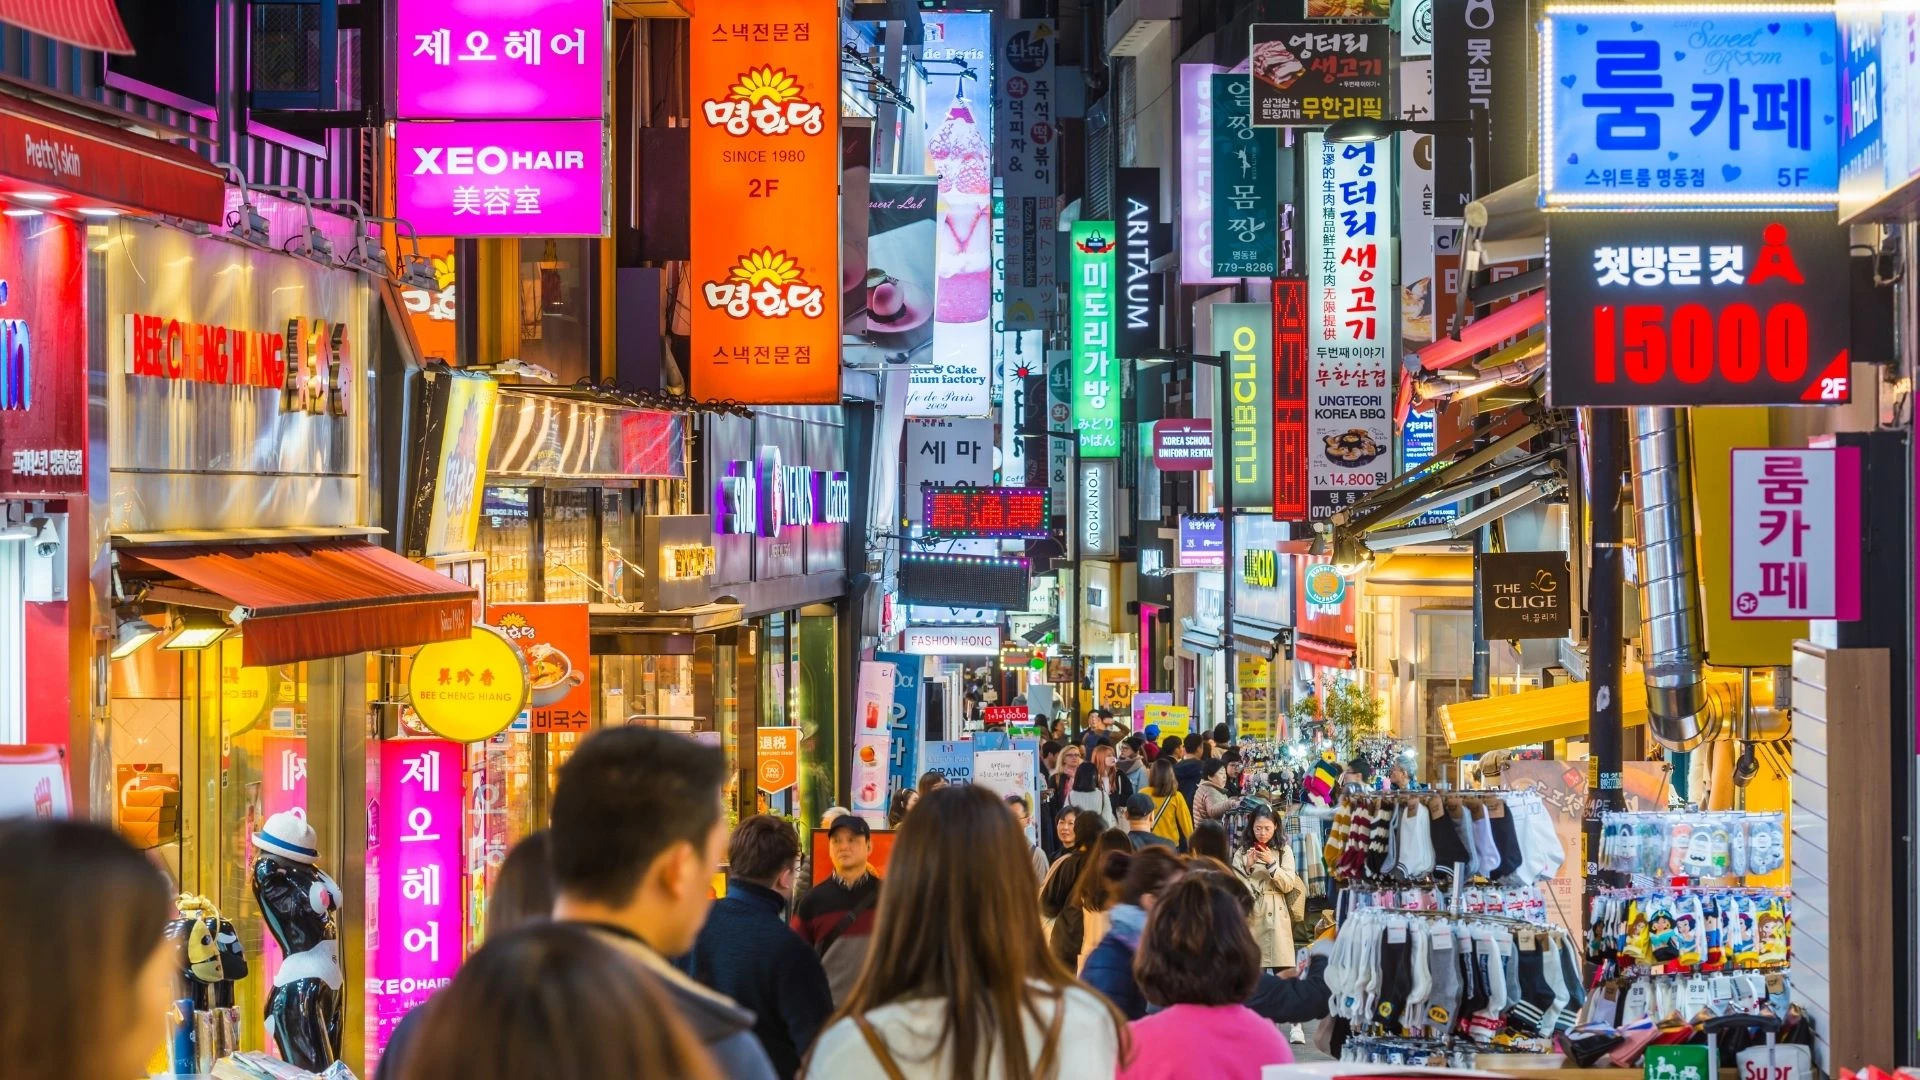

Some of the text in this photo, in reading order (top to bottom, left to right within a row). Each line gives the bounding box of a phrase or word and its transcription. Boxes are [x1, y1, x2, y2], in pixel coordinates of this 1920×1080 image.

[711, 22, 810, 42] 스낵전문점
[412, 27, 586, 66] 제오헤어
[1289, 33, 1368, 59] 엉터리
[1311, 55, 1382, 84] 생고기
[703, 97, 824, 136] 명화당
[1262, 109, 1300, 119] 된장찌개
[1302, 96, 1382, 119] 무한리필
[412, 146, 584, 176] XEO HAIR
[722, 150, 806, 163] SINCE 1980
[1584, 168, 1705, 187] 스위트룸 명동점
[1777, 167, 1810, 187] 5F
[748, 177, 779, 198] 2F
[452, 185, 542, 217] 美容室
[897, 196, 926, 209] Lab
[1339, 141, 1377, 340] 엉터리 생고기
[1127, 197, 1151, 329] ARITAUM
[1232, 251, 1257, 260] 명동점
[1594, 245, 1744, 286] 첫방문 컷
[1217, 263, 1274, 273] 779-8286
[703, 281, 825, 318] 명화당
[1083, 262, 1110, 409] 미도리가방
[1594, 303, 1808, 384] 15000
[134, 314, 163, 375] BEE
[167, 319, 228, 385] CHENG
[233, 330, 284, 389] HIANG
[712, 345, 811, 365] 스낵전문점
[1316, 347, 1385, 359] 두번째 이야기
[947, 364, 977, 374] Cake
[1315, 366, 1386, 388] 무한삼겹
[942, 373, 986, 386] factory
[1821, 378, 1847, 399] 2F
[942, 391, 974, 402] Paris
[1233, 326, 1257, 484] CLUBCLIO
[1318, 396, 1382, 406] UNGTEORI
[1078, 418, 1114, 429] みどり
[1315, 409, 1386, 420] KOREA BBQ
[1080, 434, 1116, 446] かばん
[1163, 437, 1212, 445] KOREA SCHOOL
[920, 440, 981, 464] 세마
[1159, 449, 1188, 457] UNIFORM
[783, 466, 813, 525] VENUS
[1089, 470, 1098, 548] TONYMOLY
[1758, 456, 1811, 609] 룸카페
[1493, 584, 1520, 593] THE
[1495, 595, 1557, 609] CLIGE
[1738, 594, 1758, 611] 5F
[911, 635, 992, 646] FASHION HONG
[420, 691, 512, 701] BEE CHENG HIANG
[400, 750, 440, 962] 제오헤어
[1689, 984, 1705, 994] 양말
